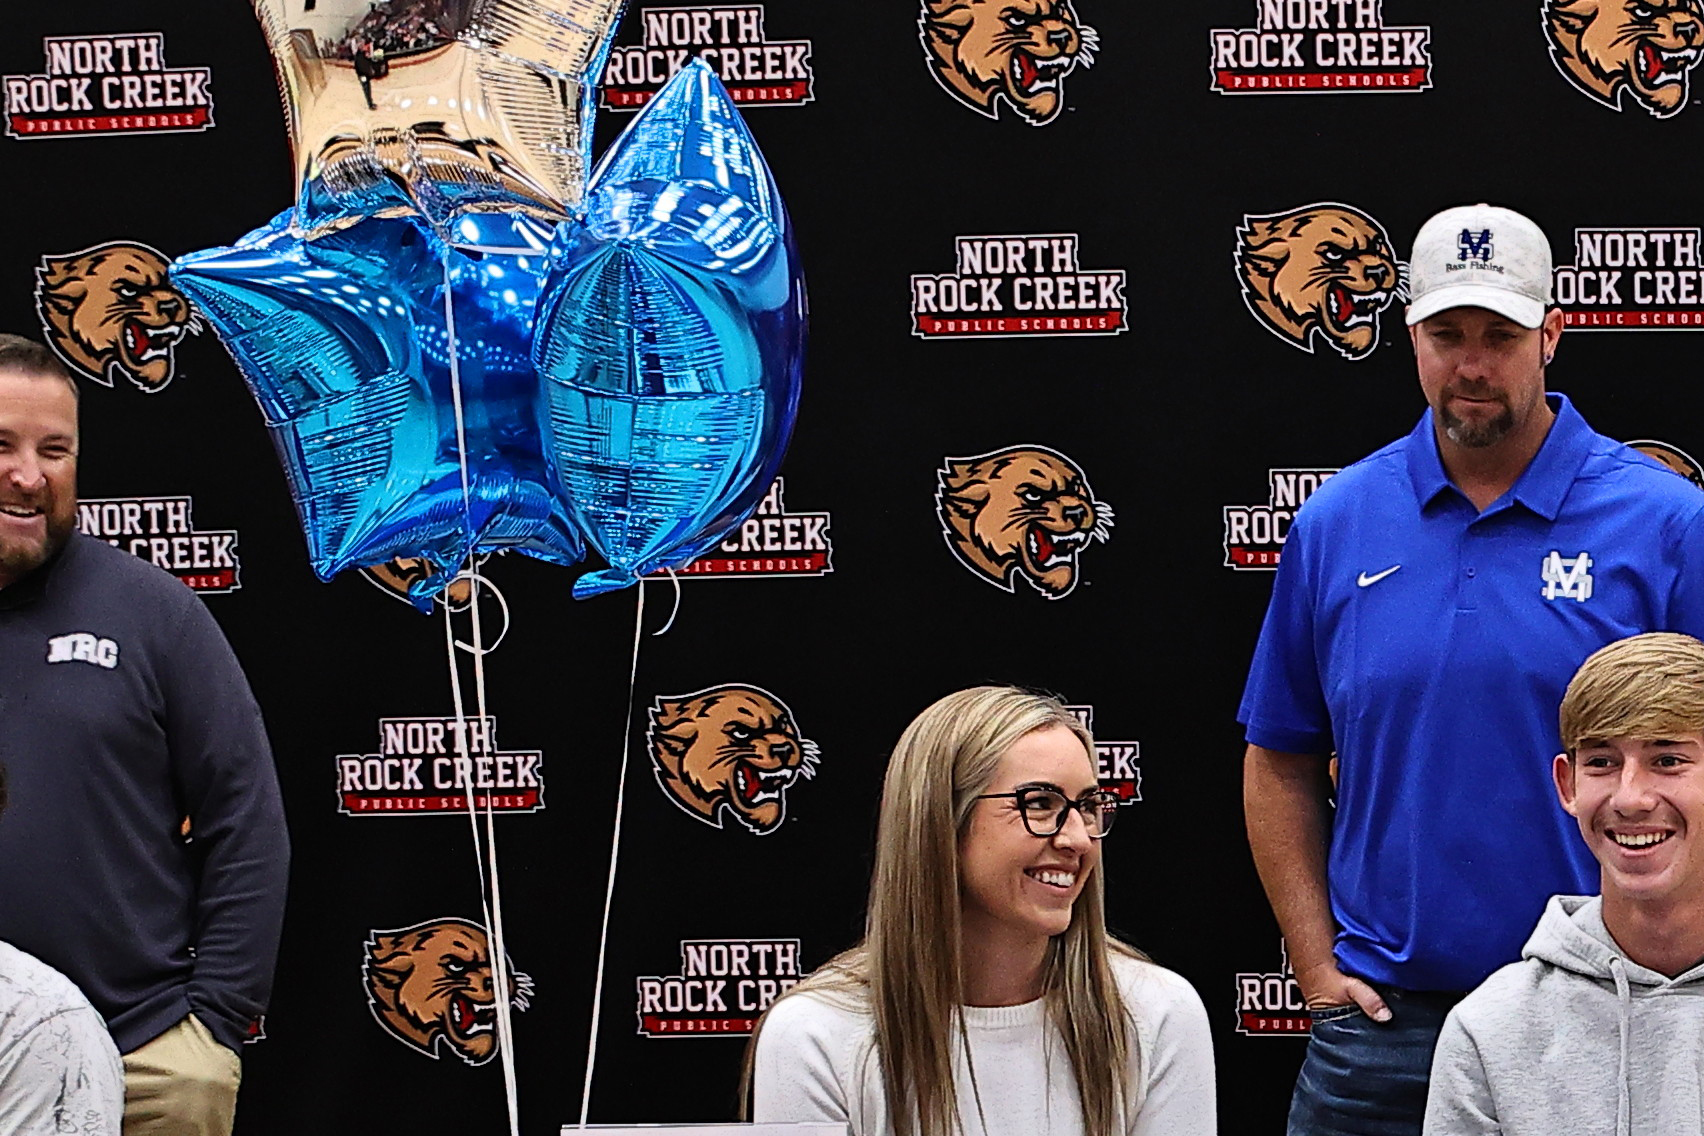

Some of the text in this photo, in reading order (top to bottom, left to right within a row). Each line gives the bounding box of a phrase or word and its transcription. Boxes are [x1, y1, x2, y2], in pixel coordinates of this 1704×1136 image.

[647, 10, 760, 46] NORTH
[1262, 0, 1378, 30] NORTH
[50, 38, 160, 75] NORTH
[1216, 32, 1426, 68] ROCK CREEK
[605, 50, 689, 85] ROCK
[1234, 74, 1410, 88] PUBLIC SCHOOLS
[8, 72, 207, 114] ROCK CREEK
[26, 114, 195, 132] PUBLIC SCHOOLS
[961, 239, 1073, 275] NORTH
[1580, 233, 1696, 267] NORTH
[1446, 261, 1504, 275] Bass Fishing
[916, 275, 1121, 313] ROCK CREEK
[1554, 271, 1622, 304] OCK
[934, 317, 1107, 332] PUBLIC SCHOOLS
[1565, 313, 1624, 325] UBLIC
[80, 501, 189, 536] NORTH
[1229, 511, 1299, 544] ROC
[727, 559, 812, 571] SCHOOLS
[47, 632, 119, 669] NRC
[384, 721, 492, 754] NORTH
[341, 755, 538, 791] ROCK CREEK
[360, 798, 426, 810] PUBLIC
[686, 944, 796, 976] NORTH
[642, 980, 727, 1012] ROCK
[660, 1020, 730, 1031] PUBLIC
